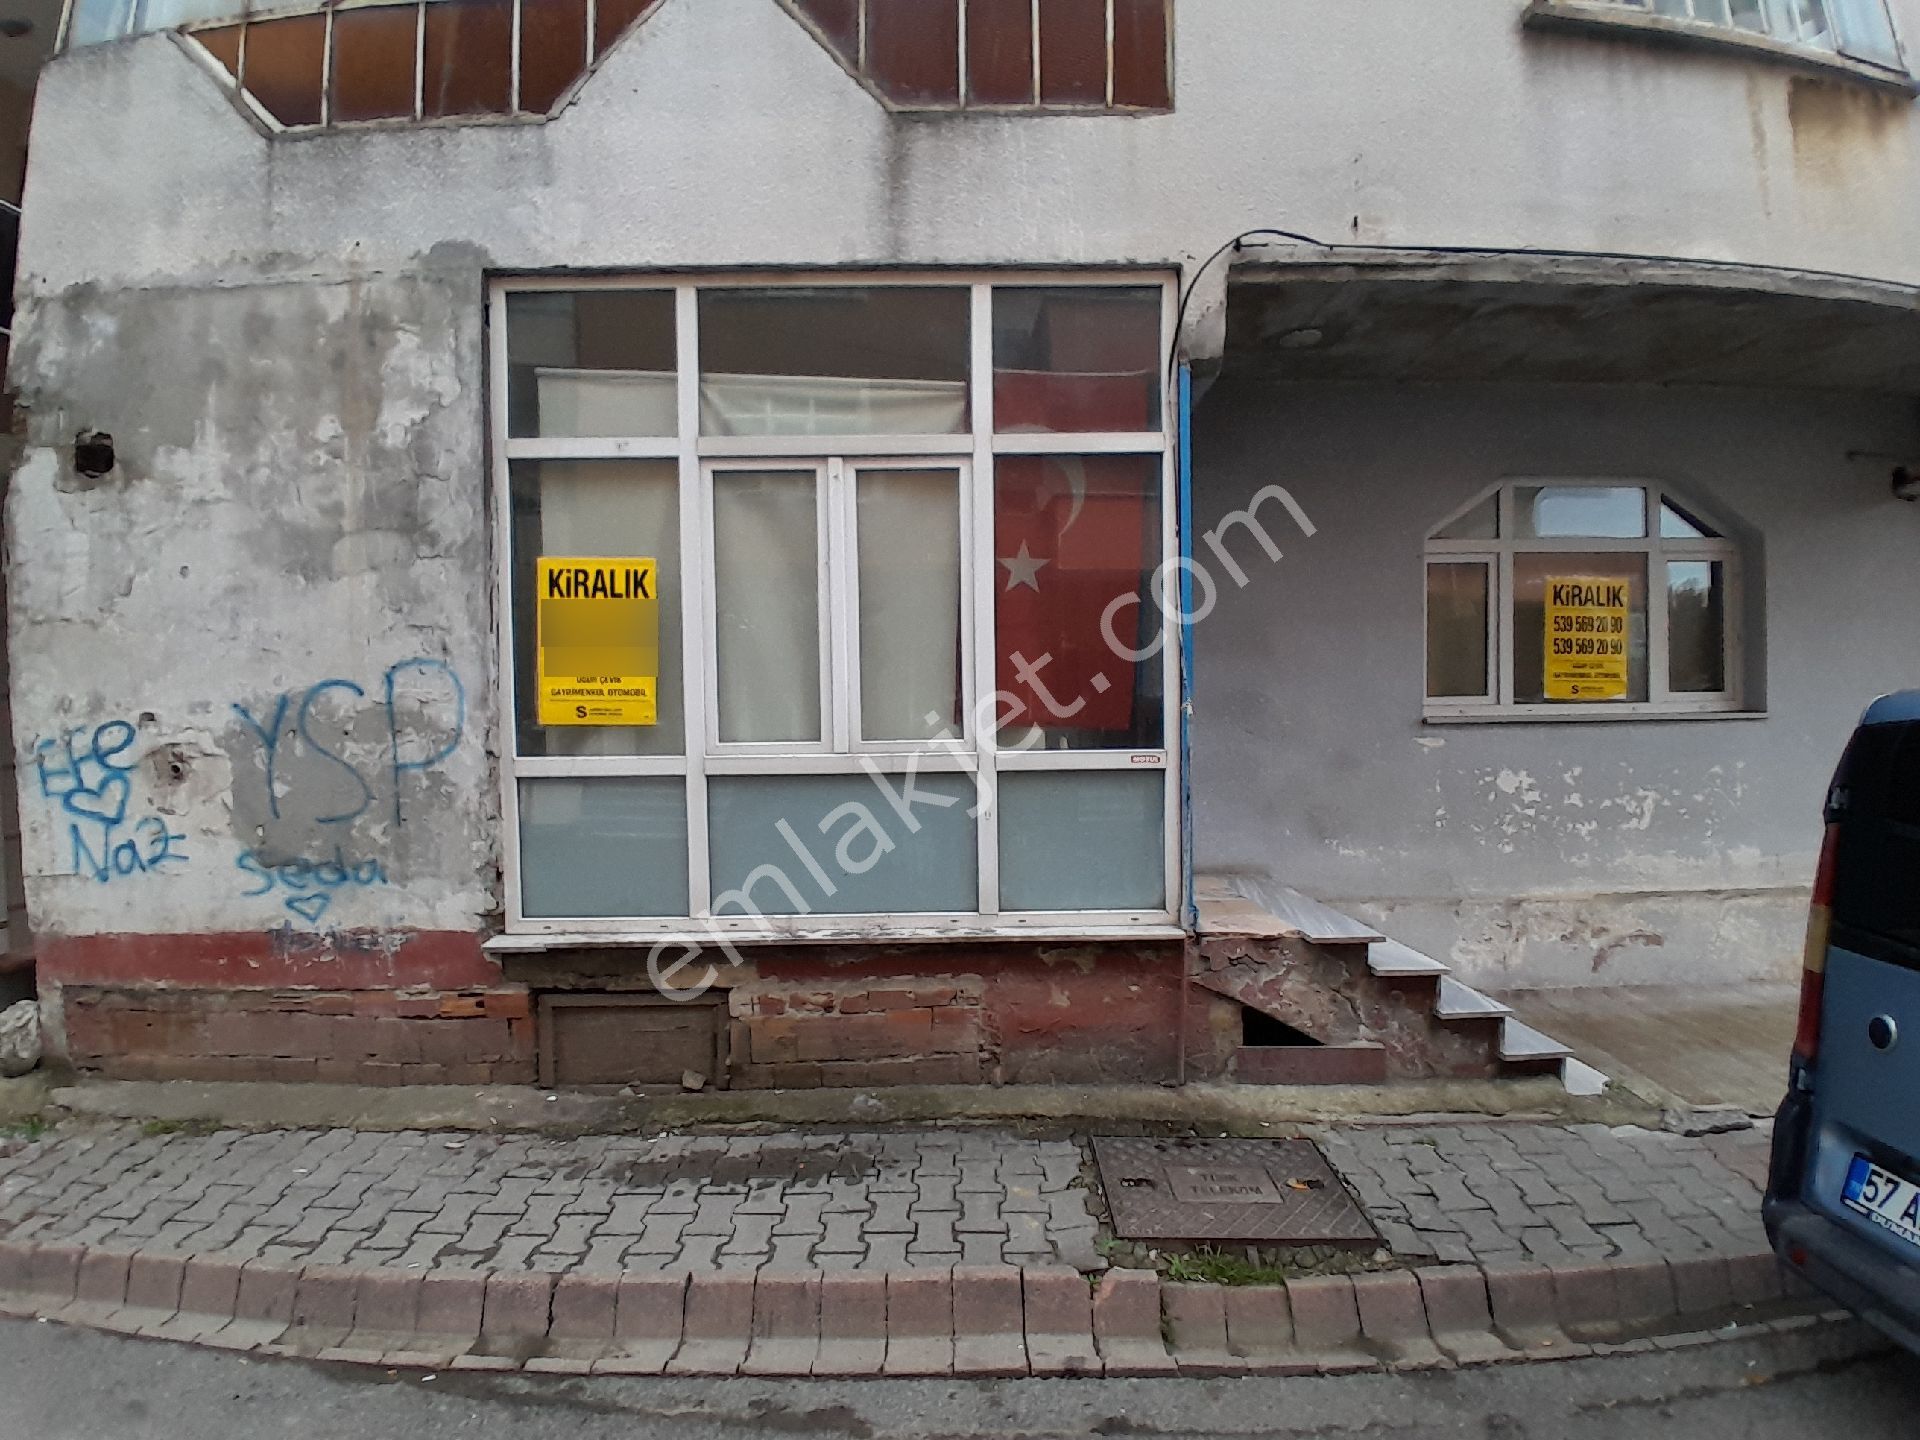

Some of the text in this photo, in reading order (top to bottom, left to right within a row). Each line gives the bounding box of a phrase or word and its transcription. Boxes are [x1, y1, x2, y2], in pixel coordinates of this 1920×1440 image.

[1553, 615, 1573, 632] 539
[1575, 616, 1594, 632] 569
[1553, 637, 1573, 654] 539
[1575, 638, 1594, 654] 569
[1596, 638, 1608, 654] 20
[1571, 685, 1580, 695] S
[576, 705, 588, 718] S
[231, 657, 466, 828] YSP
[1862, 1169, 1901, 1208] 57
